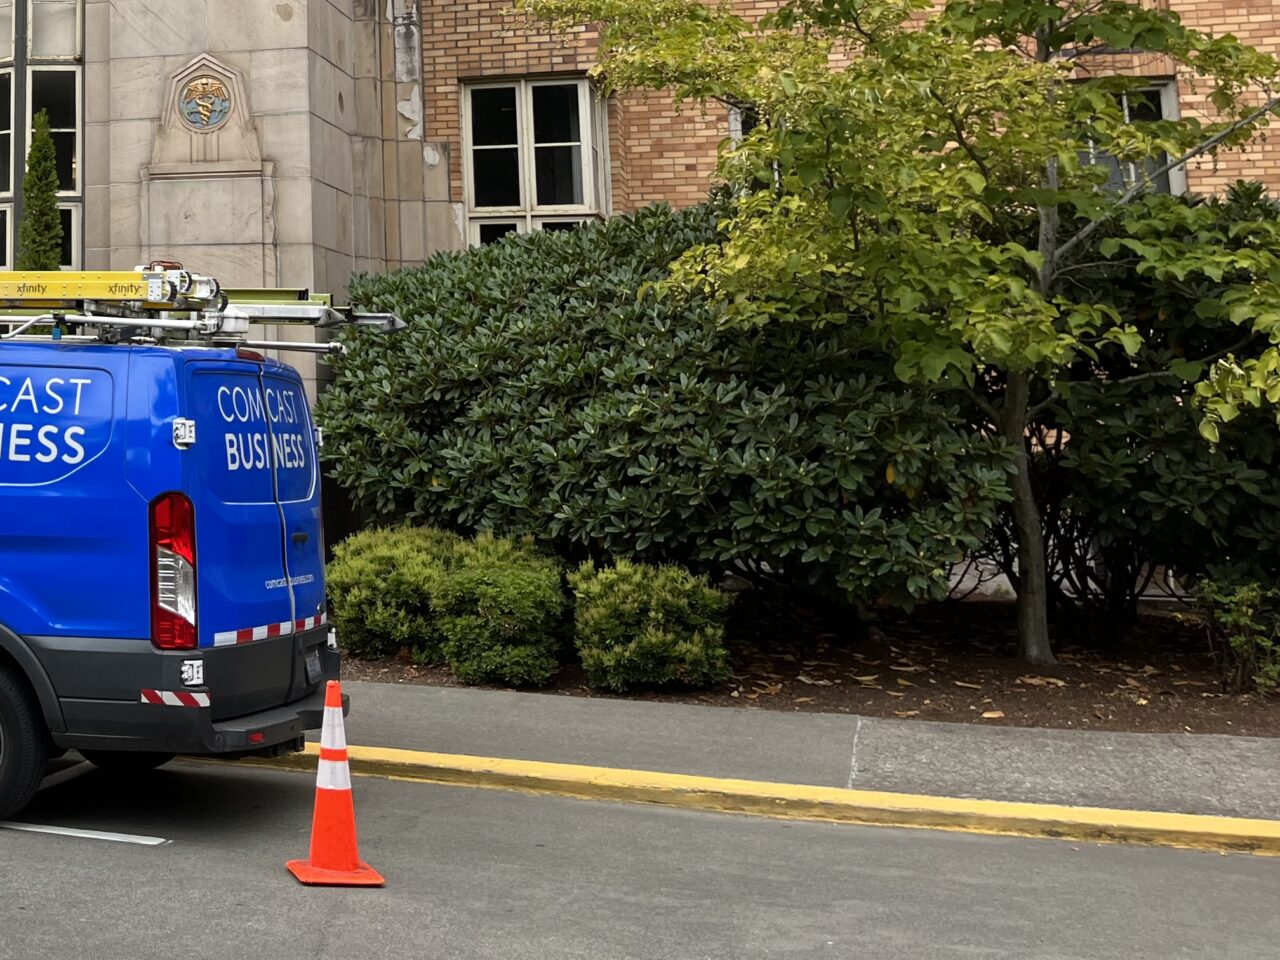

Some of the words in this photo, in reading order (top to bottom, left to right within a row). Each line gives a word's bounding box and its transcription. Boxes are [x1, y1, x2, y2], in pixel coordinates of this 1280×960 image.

[16, 283, 47, 295] xfinity
[108, 283, 140, 295] xfinity
[217, 386, 298, 424] COMCAST
[224, 432, 305, 471] BUSINESS
